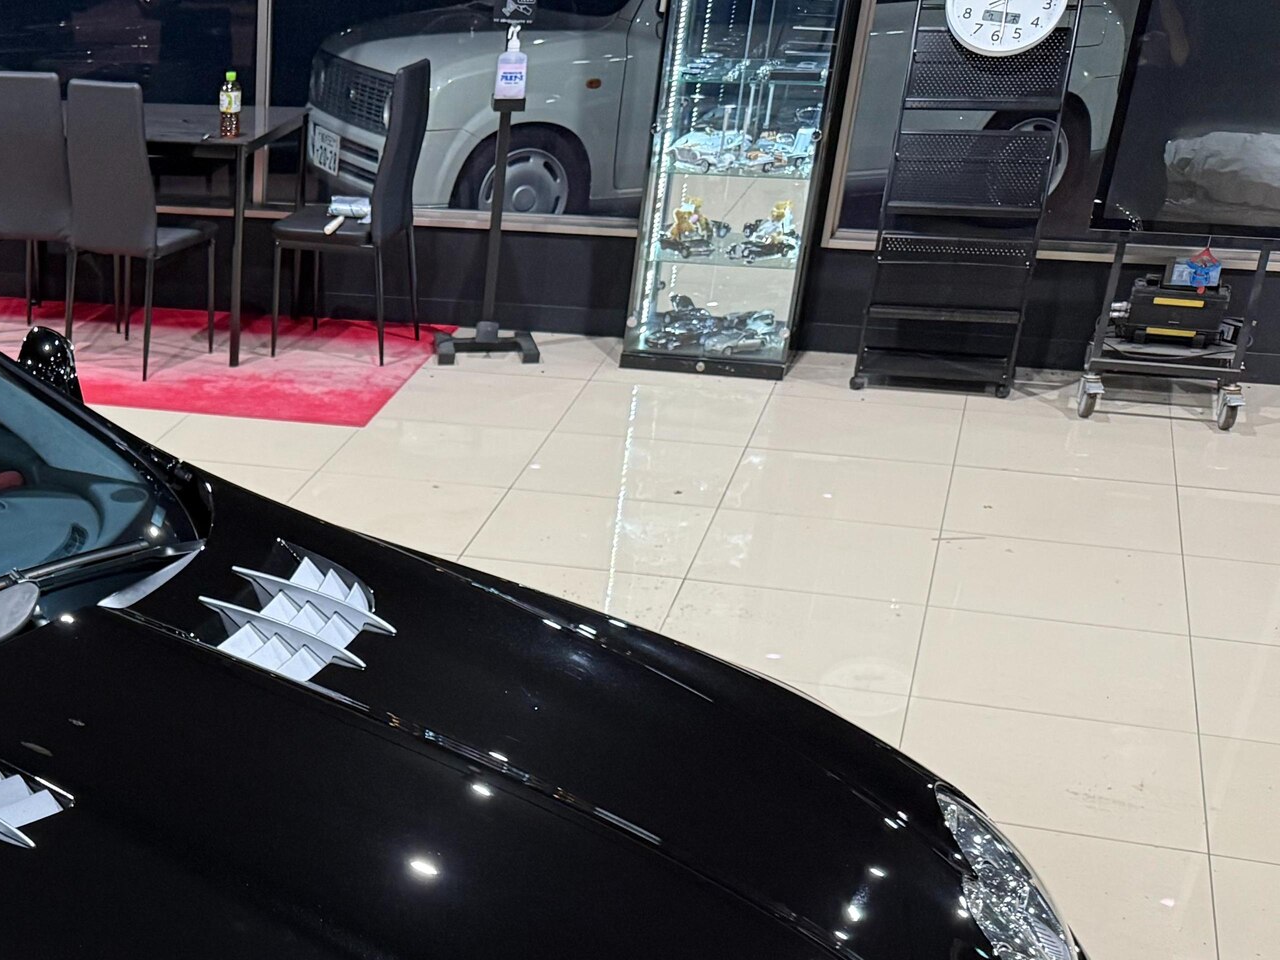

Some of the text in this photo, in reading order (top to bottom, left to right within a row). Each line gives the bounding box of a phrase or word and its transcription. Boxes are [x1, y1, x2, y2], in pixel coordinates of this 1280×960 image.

[962, 7, 972, 19] 8
[973, 22, 983, 34] 7
[1030, 16, 1040, 28] 4
[990, 30, 1000, 42] 6
[1012, 27, 1022, 39] 5
